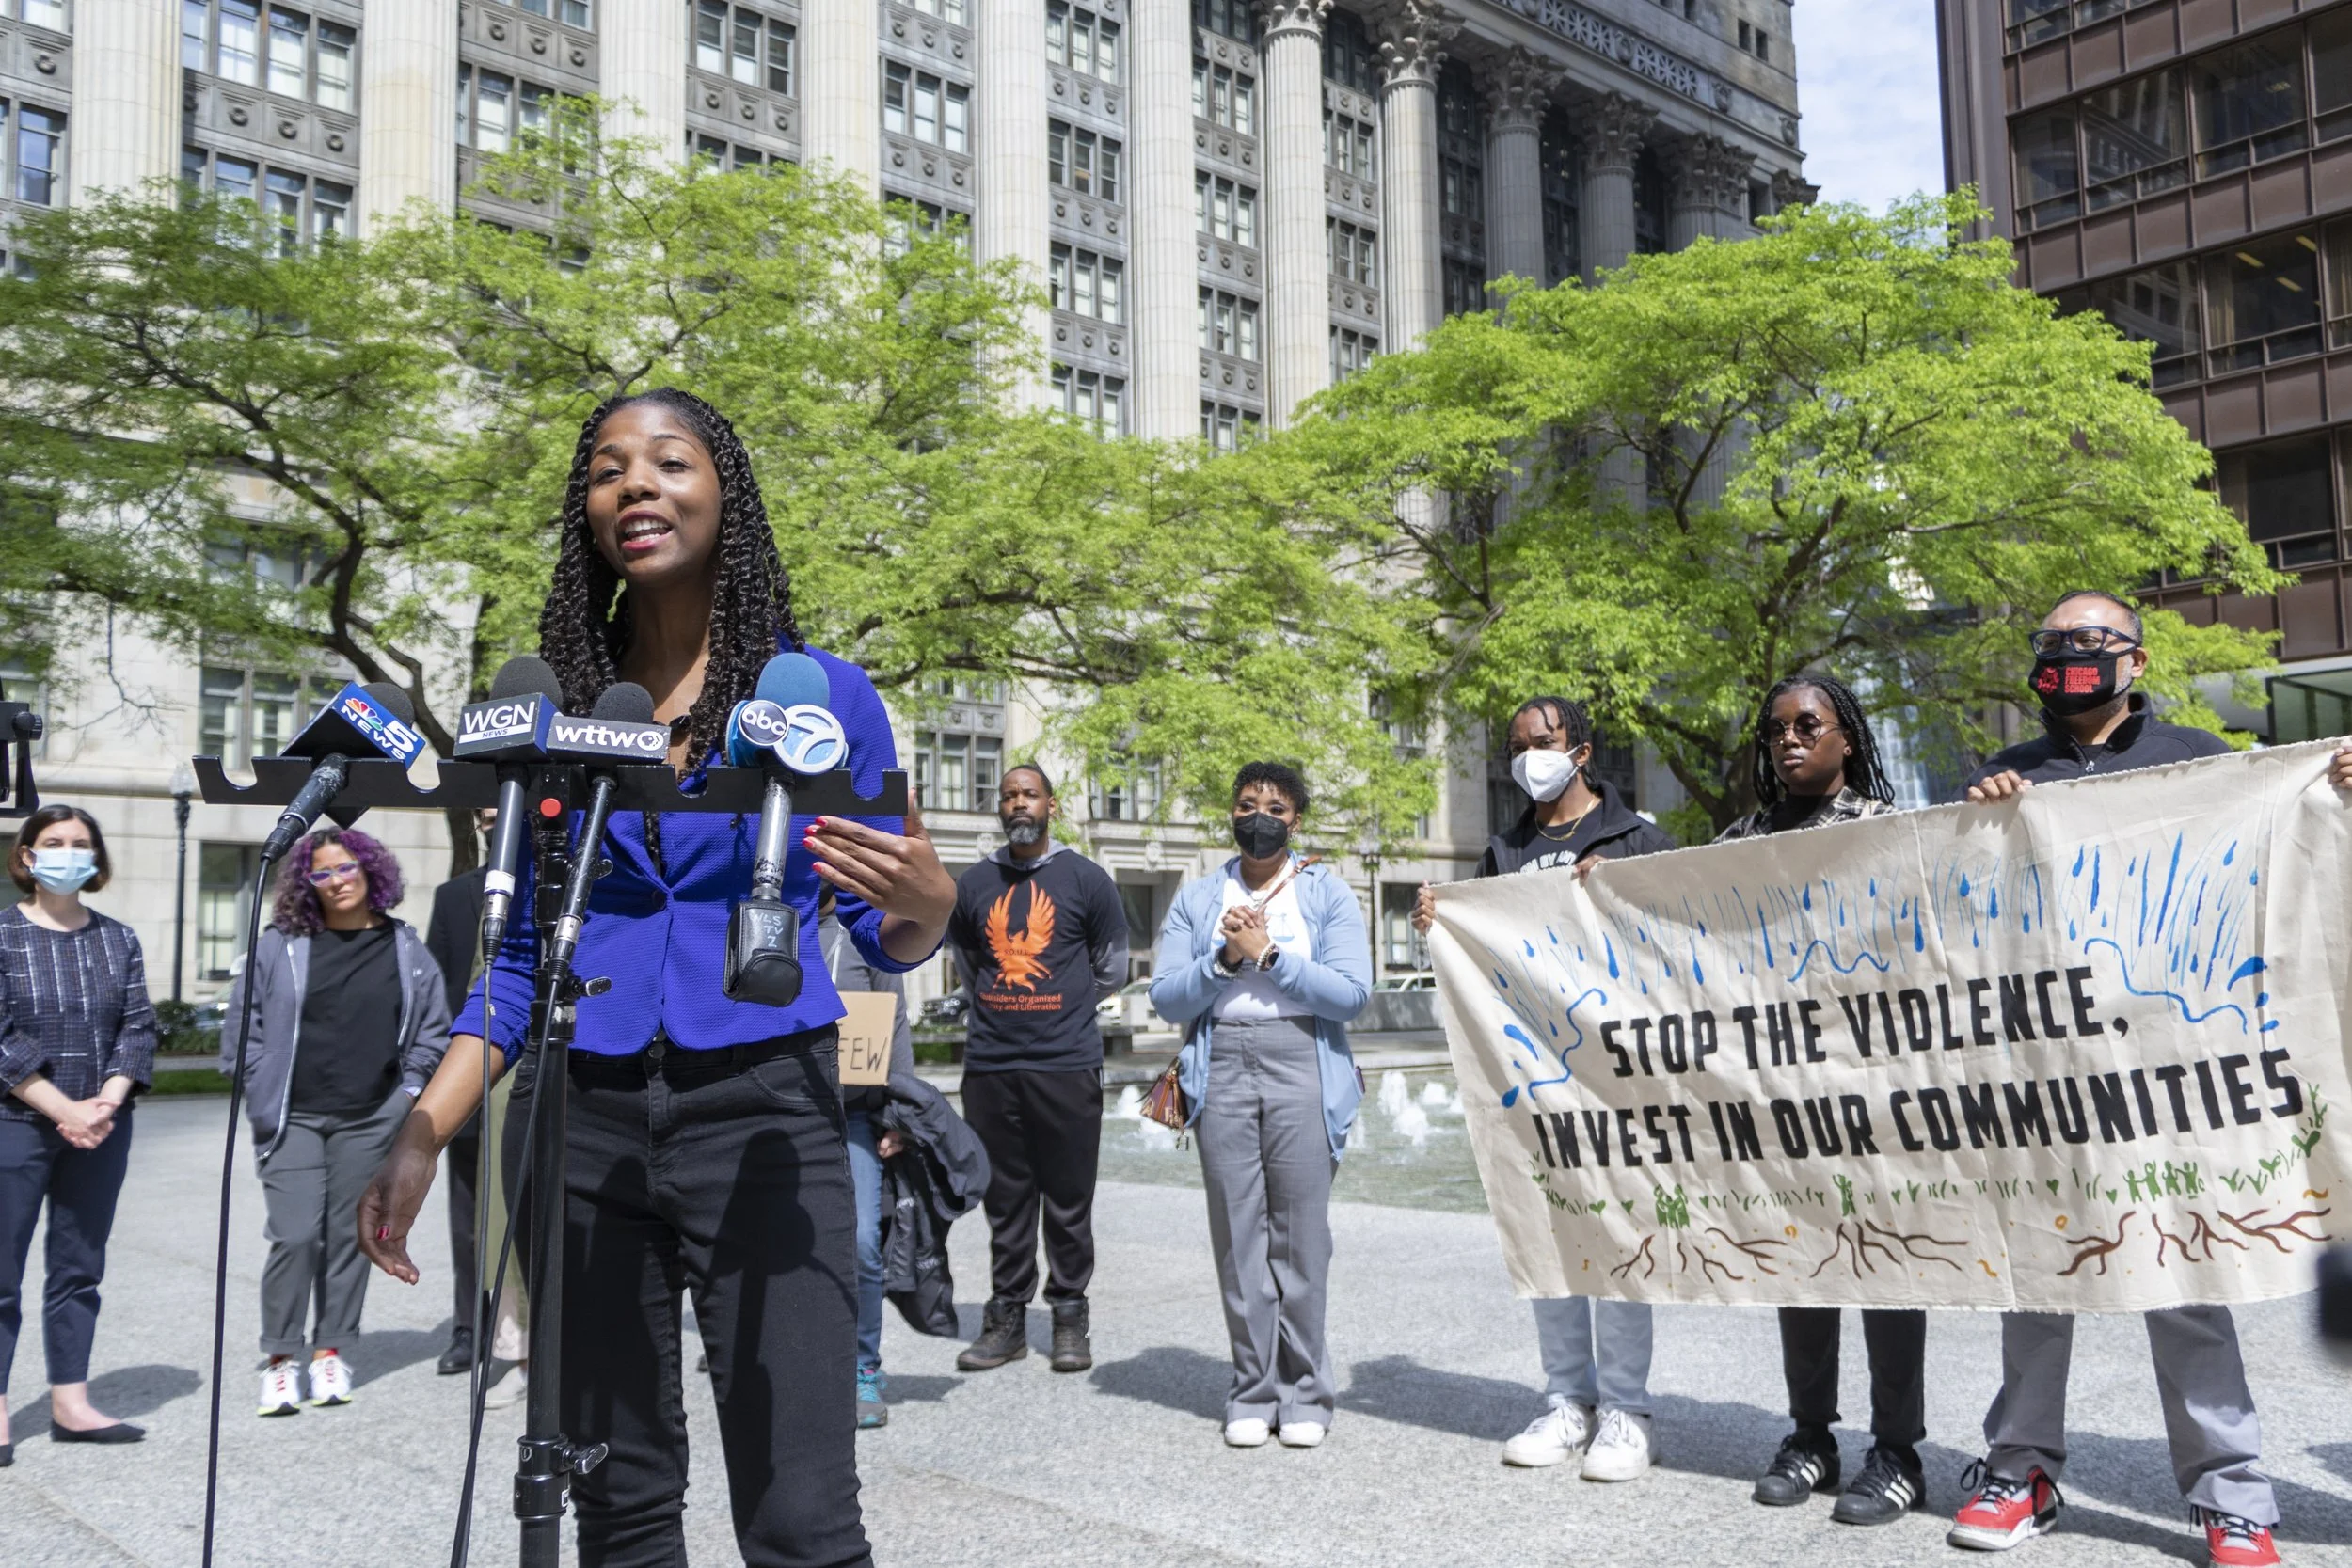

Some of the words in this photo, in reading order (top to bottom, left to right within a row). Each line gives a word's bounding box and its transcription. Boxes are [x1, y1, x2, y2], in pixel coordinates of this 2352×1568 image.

[2065, 667, 2098, 676] CHICAGO
[2065, 675, 2101, 685] FREEDOM
[2064, 685, 2094, 693] SCHOOL
[464, 701, 535, 734] WGN
[741, 708, 787, 736] abc
[341, 705, 406, 760] NEWS
[383, 720, 419, 753] 5
[482, 728, 508, 738] NEWS
[555, 724, 638, 749] wttw
[764, 926, 783, 935] TV
[1018, 994, 1062, 1005] Organized
[1599, 1010, 1718, 1078] STOP
[1732, 999, 1827, 1070] THE
[1837, 966, 2129, 1058] VIOLENCE,
[1532, 1104, 1695, 1169] INVEST
[1708, 1101, 1764, 1162] IN
[1770, 1094, 1880, 1159] OUR
[1889, 1047, 2304, 1151] COMMUNITIES
